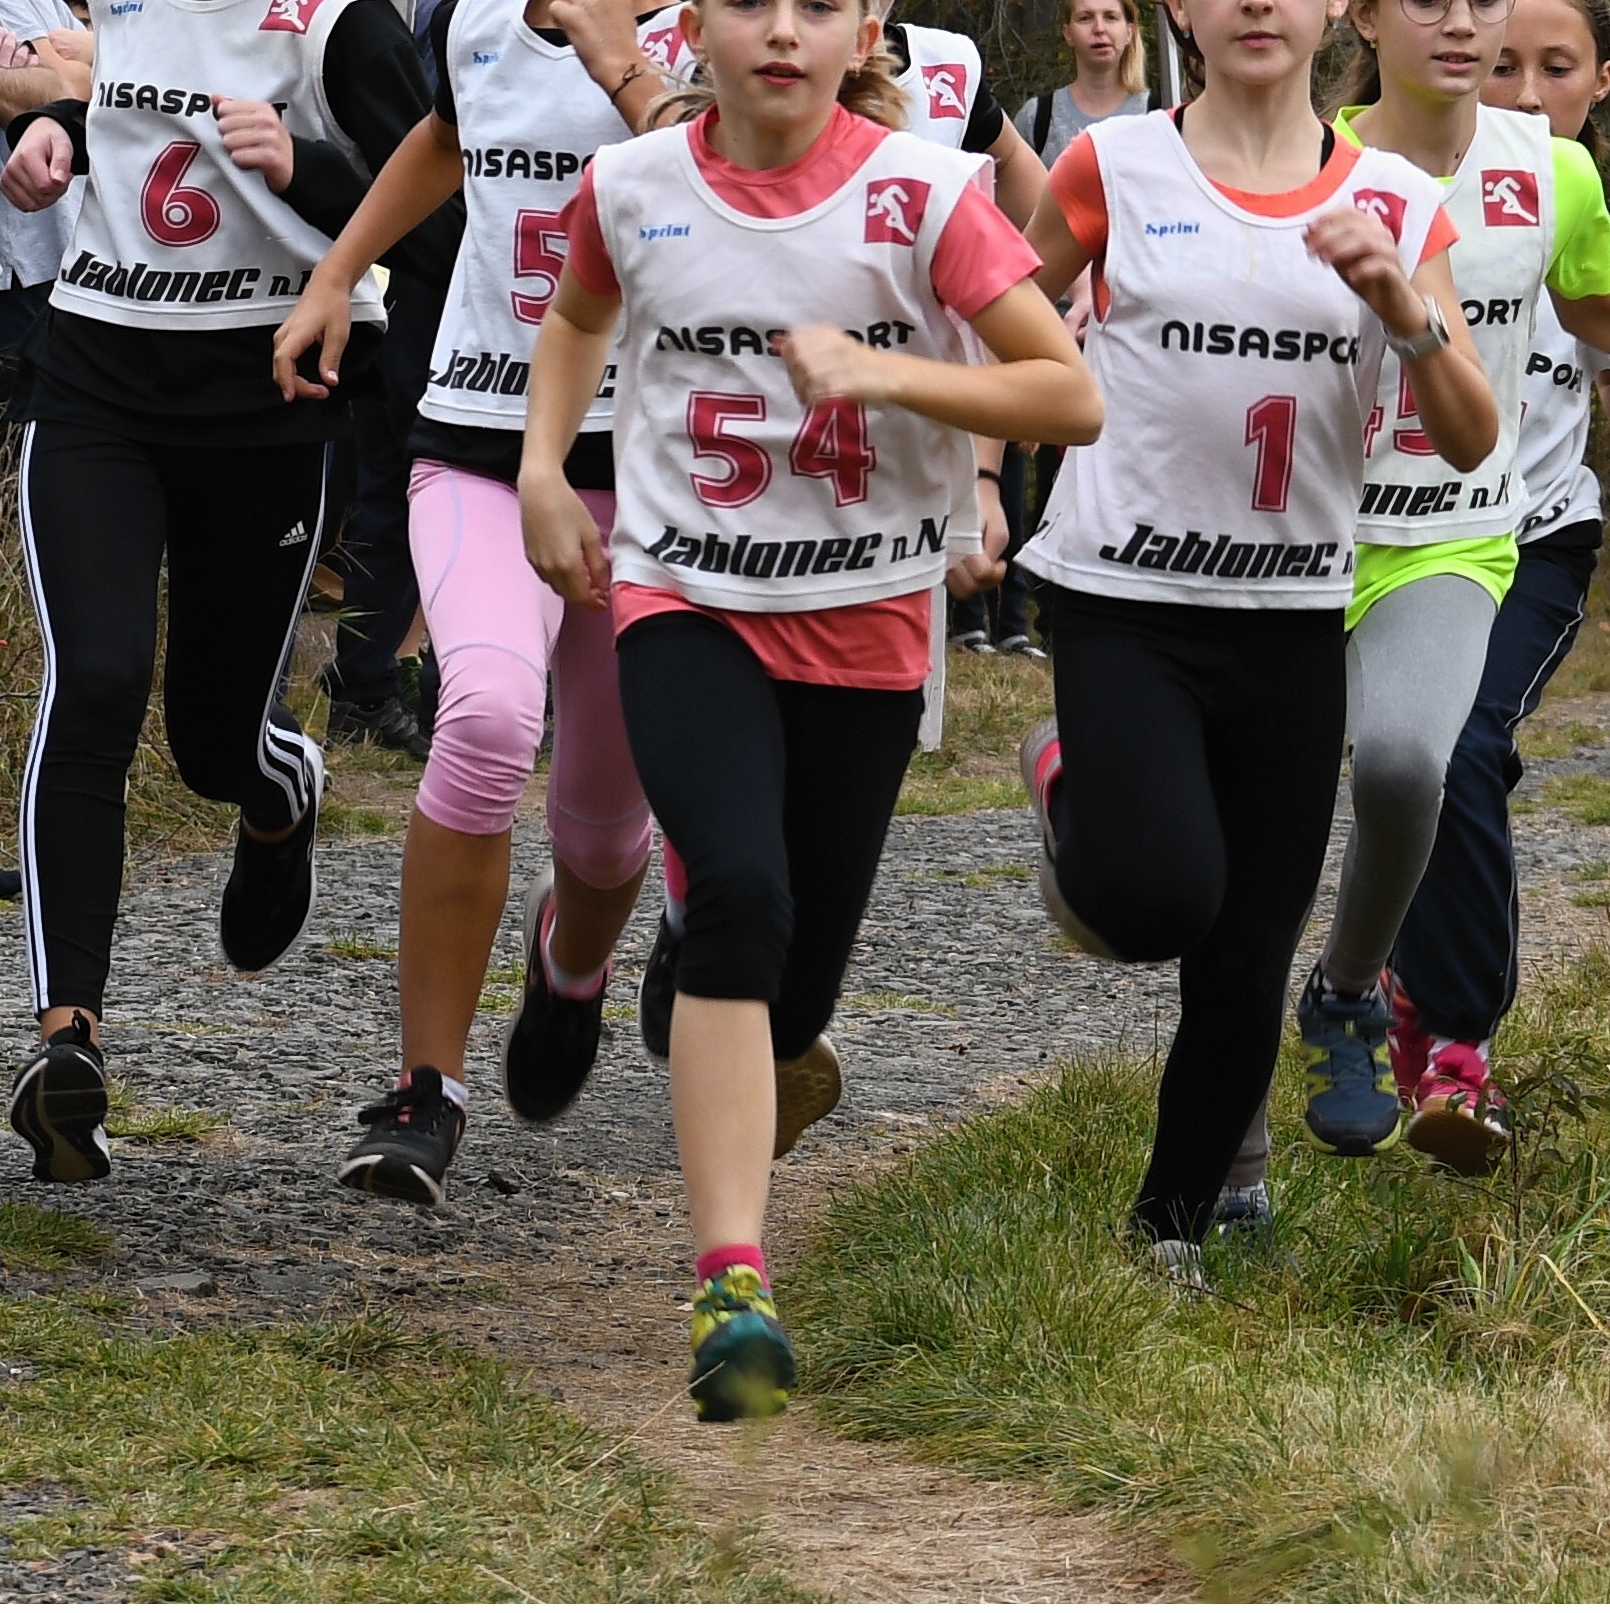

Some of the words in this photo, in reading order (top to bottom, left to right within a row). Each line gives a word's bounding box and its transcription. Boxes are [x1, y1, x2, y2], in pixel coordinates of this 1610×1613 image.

[140, 140, 221, 249] 6
[686, 390, 877, 509] 54
[1244, 395, 1297, 512] 1
[279, 534, 308, 547] adidas
[1099, 523, 1338, 578] Jablonec
